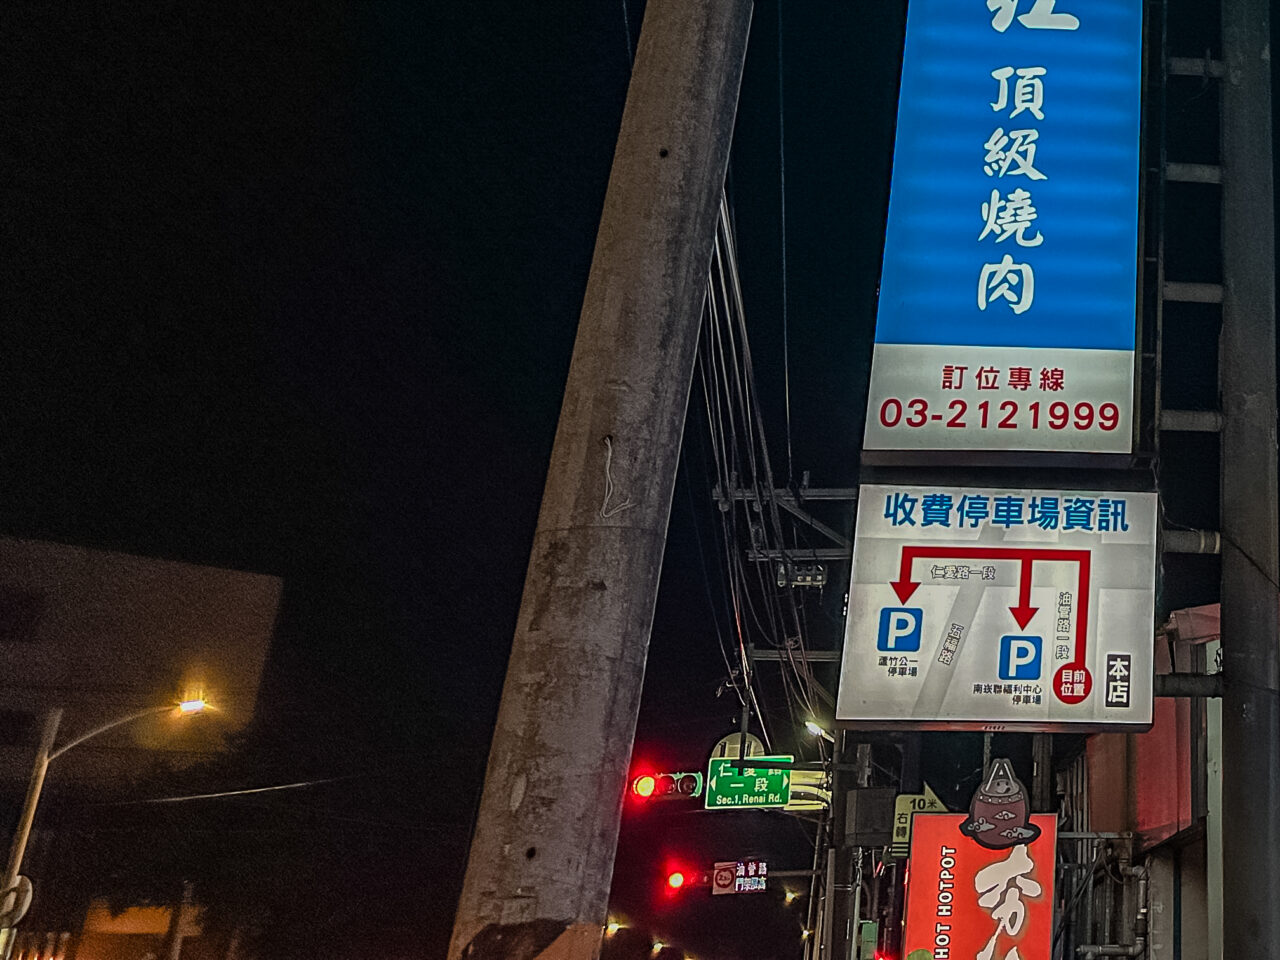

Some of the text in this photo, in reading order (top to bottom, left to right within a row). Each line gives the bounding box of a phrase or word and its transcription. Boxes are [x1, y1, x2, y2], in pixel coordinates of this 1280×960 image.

[977, 66, 1048, 315] 頂級燒肉
[942, 365, 1065, 392] 訂位專線
[879, 398, 1120, 431] 03-2121999
[883, 492, 1129, 532] 收費停車場資訊
[930, 565, 996, 580] 仁愛路一段
[887, 611, 916, 648] P
[1055, 591, 1072, 659] 油管路一段
[888, 667, 918, 677] 停車場
[1008, 640, 1036, 677] P
[1061, 669, 1085, 683] 目前
[1108, 657, 1129, 703] 本店
[1012, 695, 1042, 705] 停車場
[768, 794, 782, 803] Rd.
[934, 846, 956, 960] HOT HOTPOT
